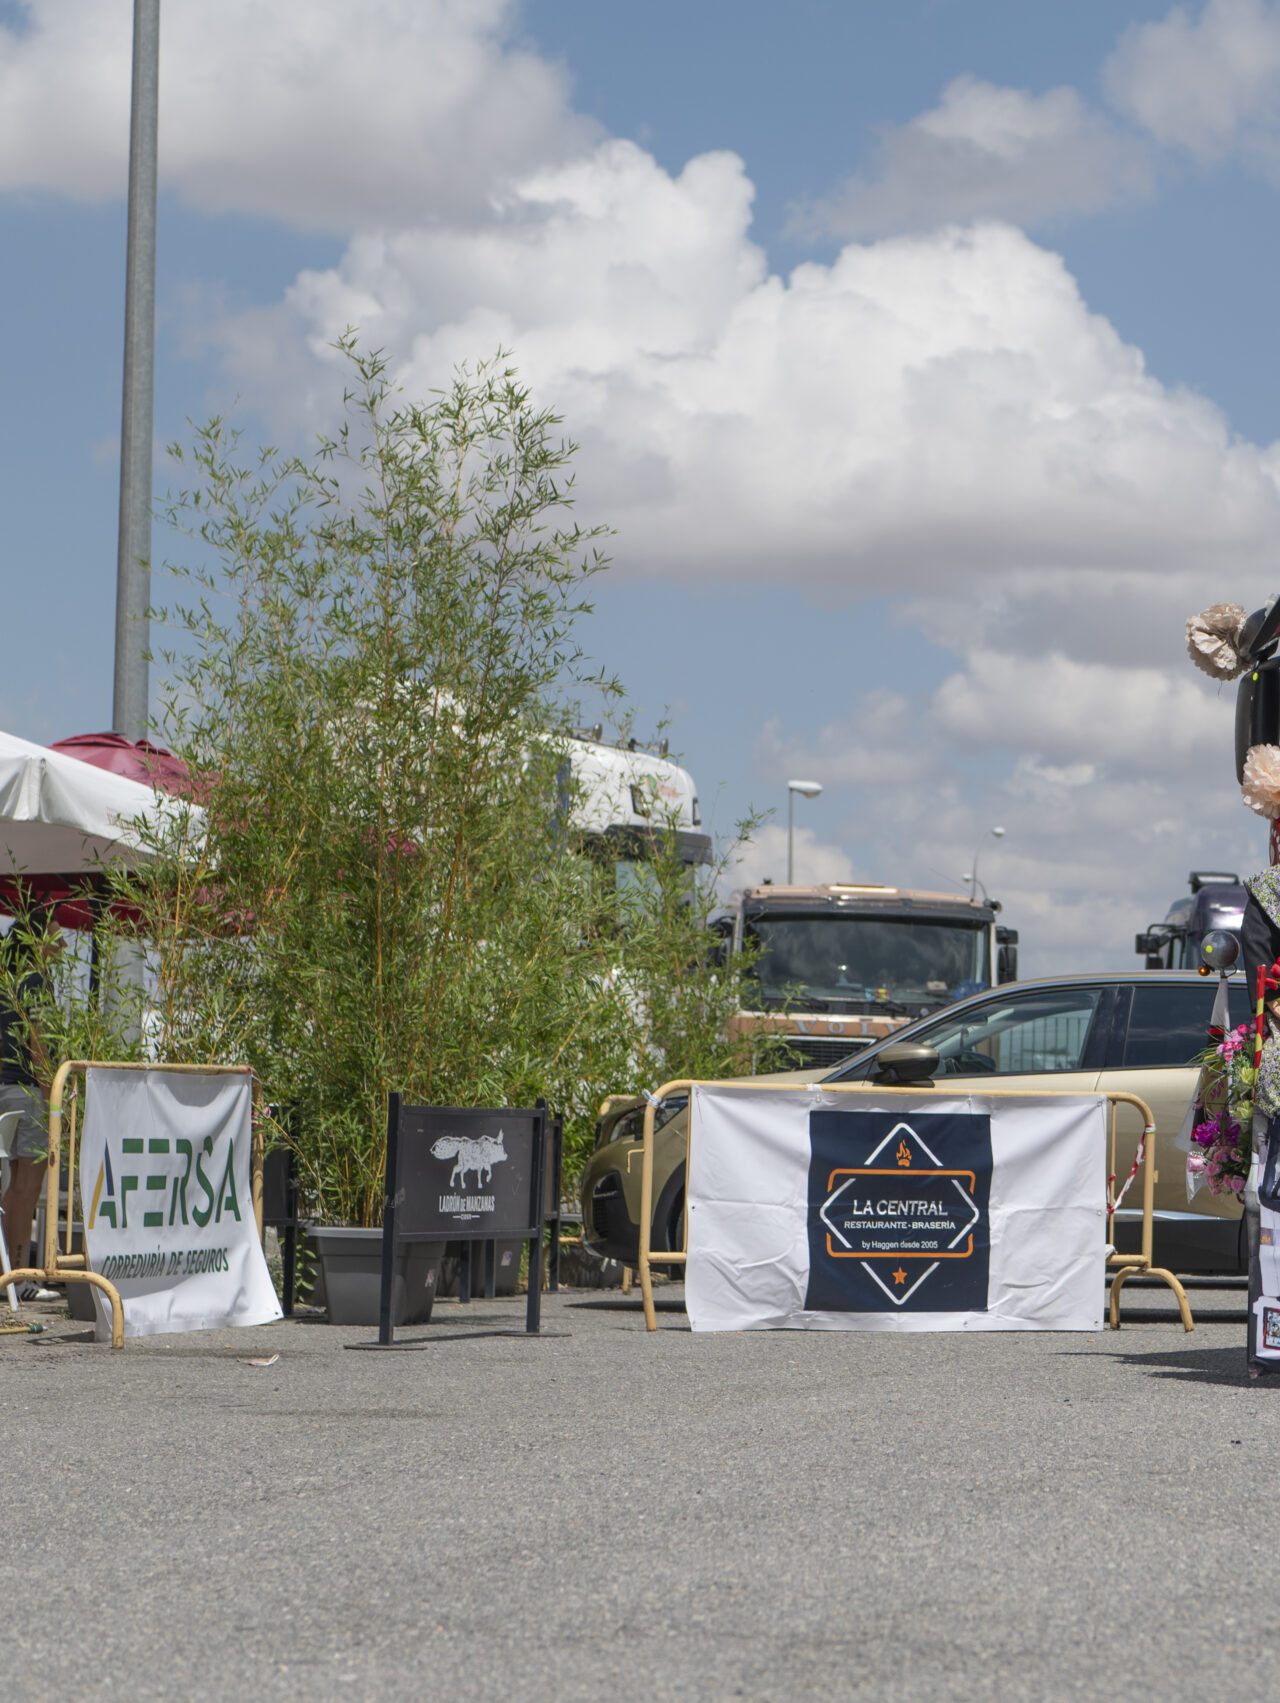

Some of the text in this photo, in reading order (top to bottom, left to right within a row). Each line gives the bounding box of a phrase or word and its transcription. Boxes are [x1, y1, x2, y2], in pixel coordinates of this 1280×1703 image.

[795, 1020, 905, 1037] VOLV
[88, 1136, 241, 1230] AFERSA
[466, 1195, 495, 1212] MANZANAS
[853, 1200, 948, 1216] LA CENTRAL
[862, 1241, 938, 1250] by Haggen desde 2005
[100, 1245, 229, 1280] CORREDURÍA DE SEGUROS
